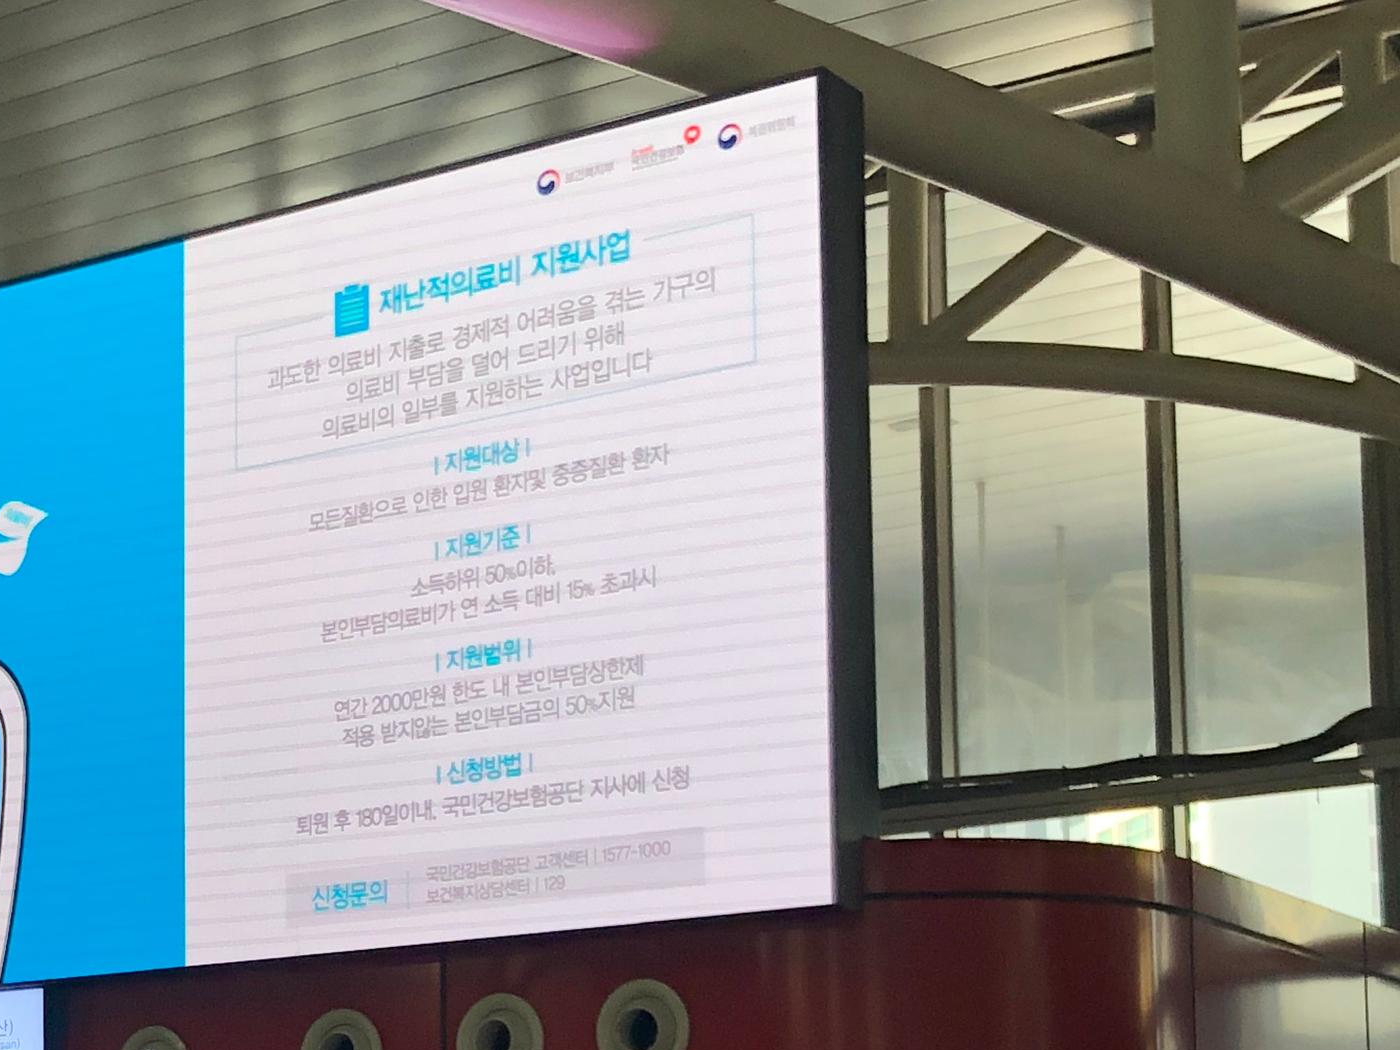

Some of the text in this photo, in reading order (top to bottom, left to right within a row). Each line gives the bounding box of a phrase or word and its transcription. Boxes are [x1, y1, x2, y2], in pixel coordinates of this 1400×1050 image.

[379, 228, 631, 314] 재난적의료비 지원사업
[267, 266, 717, 390] 과도한 의료비 지출로 경제적 어려움을 겪는 가구의
[322, 347, 653, 440] 의료비의 일부를 지원하는 사업입니다
[346, 320, 626, 404] 의료비 부담을 덜어 드리기 위해
[308, 443, 670, 533] 모든질환으로 인한 입원 환자및 중증질환 환자
[444, 438, 520, 474] 지원대상
[445, 523, 520, 561] 지원기준
[320, 564, 658, 644] 본인부담의료비가 연 소득 대비 15% 초과시
[410, 563, 480, 599] 소득하위
[446, 639, 521, 672] 지원범위
[333, 654, 646, 724] 연간 2000만원 한도 내 본인부담상한제
[342, 685, 636, 749] 적용 받지않는 본인부담금의 50%지원
[296, 810, 329, 836] 퇴원
[334, 808, 351, 832] 후
[442, 779, 584, 818] 국민건강보험공단
[590, 771, 646, 799] 지사에
[652, 764, 690, 793] 신청
[446, 753, 522, 785] 신청방법
[426, 840, 672, 882] 국민건강보험공단 고객센터 1577-1000
[426, 875, 566, 904] 보건복지상담센터 129
[312, 879, 389, 913] 신청문의
